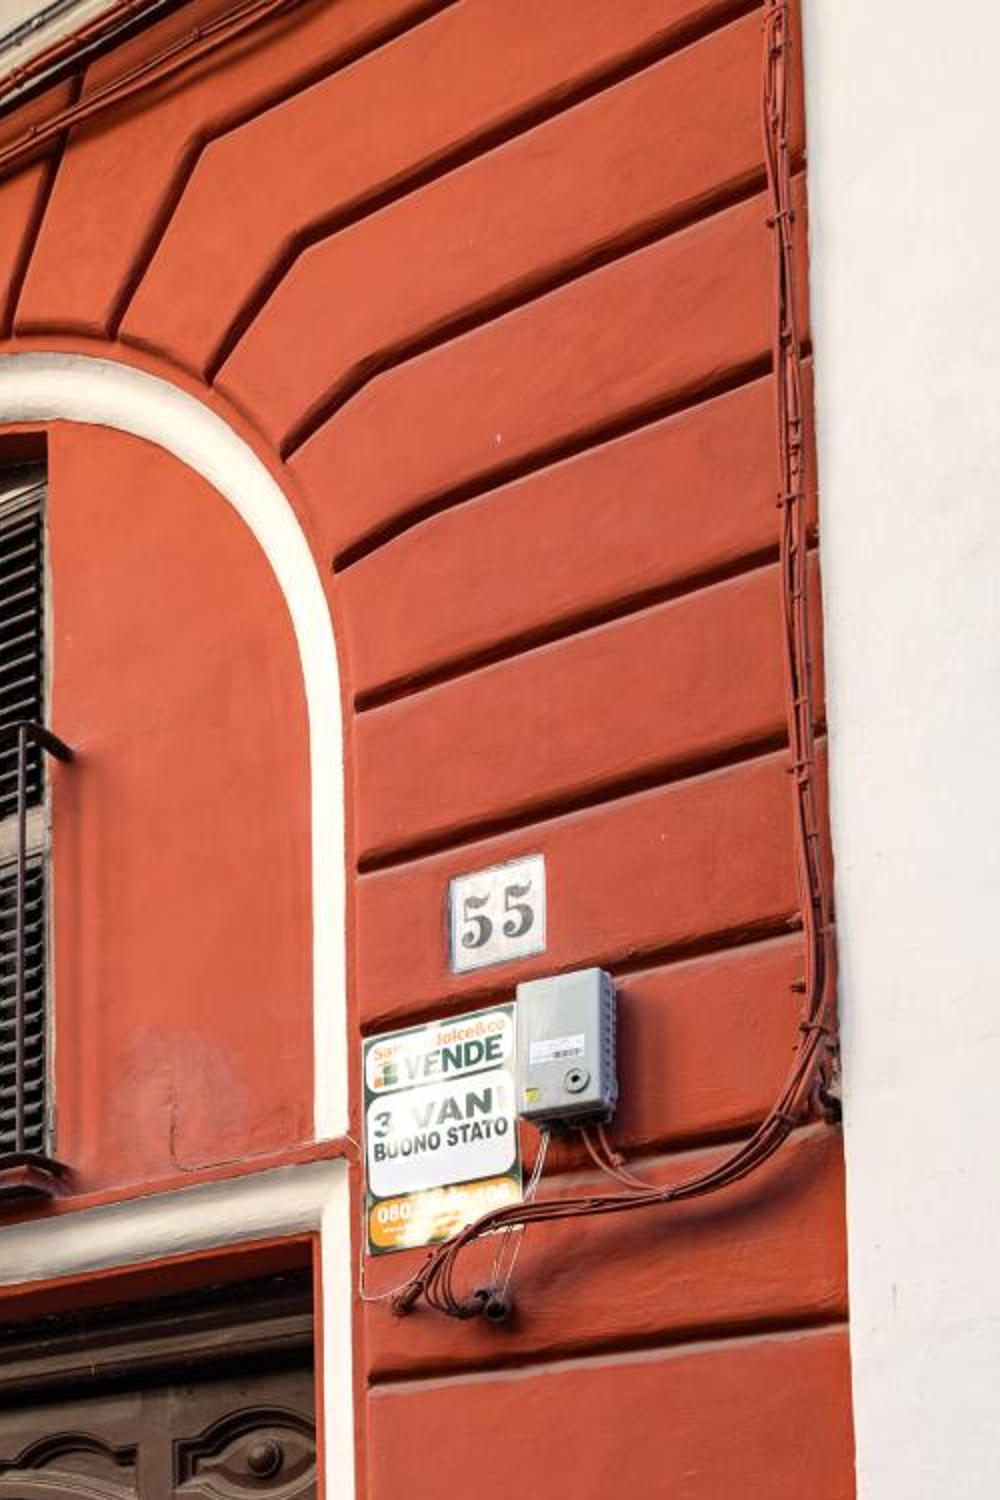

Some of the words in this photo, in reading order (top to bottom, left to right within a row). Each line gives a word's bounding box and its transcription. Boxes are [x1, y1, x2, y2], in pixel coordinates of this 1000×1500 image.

[461, 879, 535, 948] 55
[404, 1034, 503, 1081] VENDE
[373, 1111, 392, 1139] 3
[374, 1131, 441, 1163] BUONO
[447, 1117, 508, 1147] STATO
